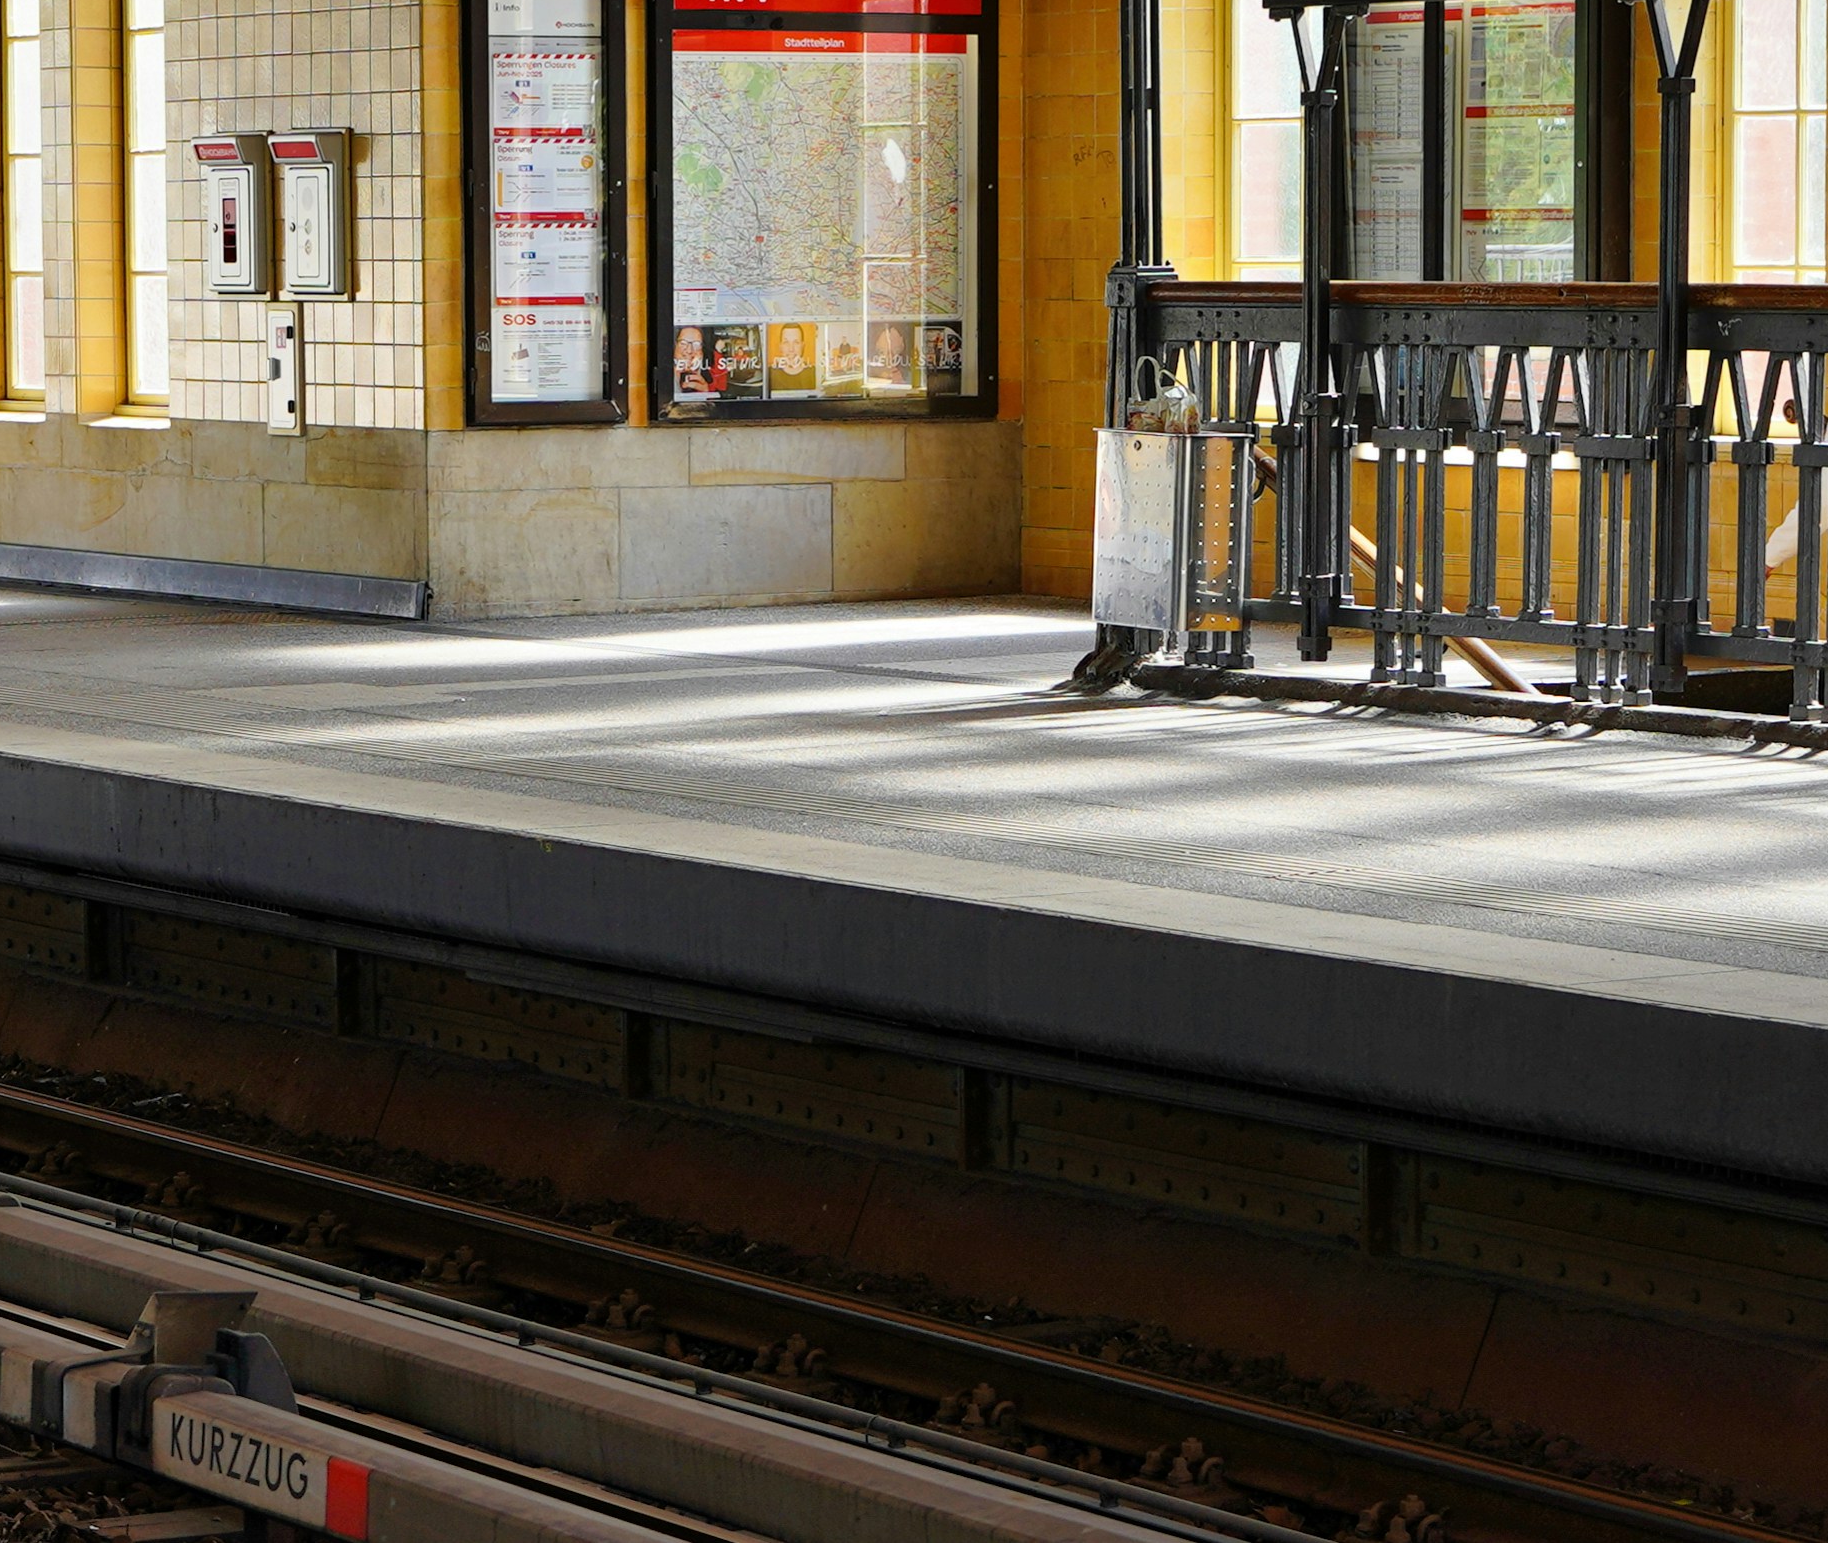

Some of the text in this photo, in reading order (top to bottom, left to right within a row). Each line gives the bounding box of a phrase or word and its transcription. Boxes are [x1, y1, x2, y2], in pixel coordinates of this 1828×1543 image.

[502, 4, 521, 12] Info
[785, 37, 845, 49] Stadtteilplan
[503, 313, 537, 326] SOS
[171, 1412, 308, 1499] KURZZUG
